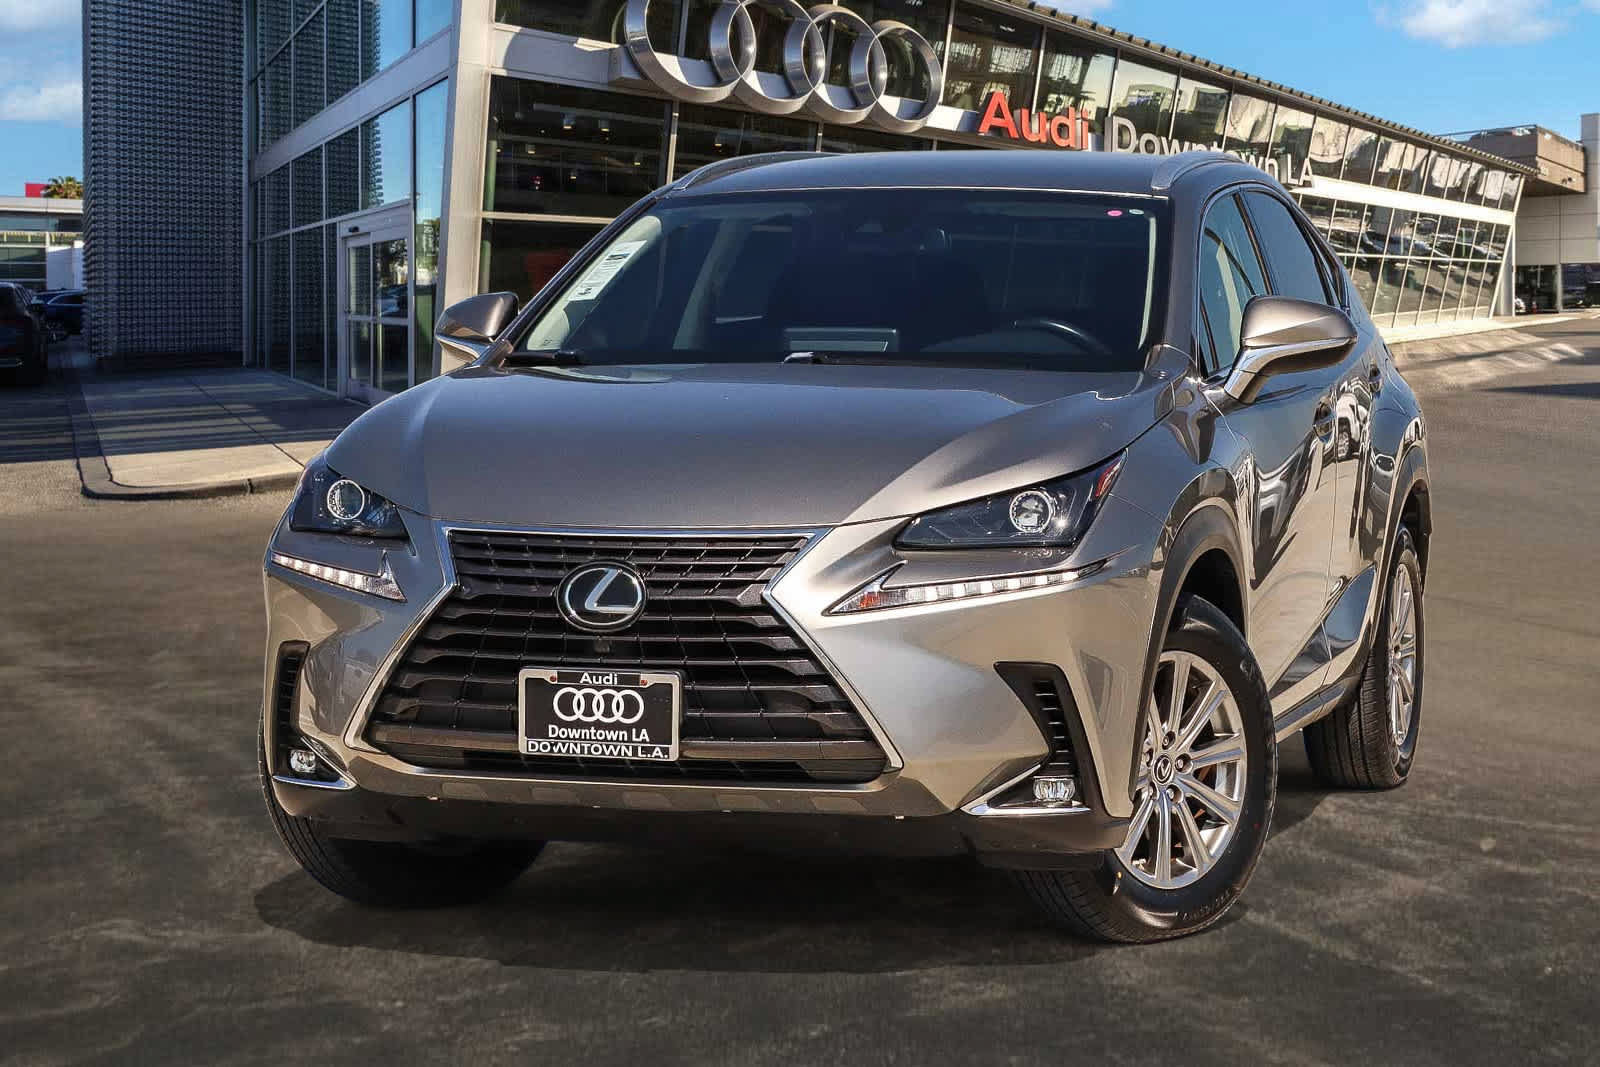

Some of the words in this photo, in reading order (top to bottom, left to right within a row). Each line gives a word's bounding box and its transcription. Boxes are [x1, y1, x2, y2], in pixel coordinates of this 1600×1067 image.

[978, 90, 1089, 149] Audi
[1287, 153, 1314, 187] LA
[579, 672, 618, 686] Audi
[549, 725, 628, 742] Downtown
[632, 728, 650, 742] LA
[528, 740, 632, 757] DOWNTOWN
[638, 747, 669, 759] L.A.
